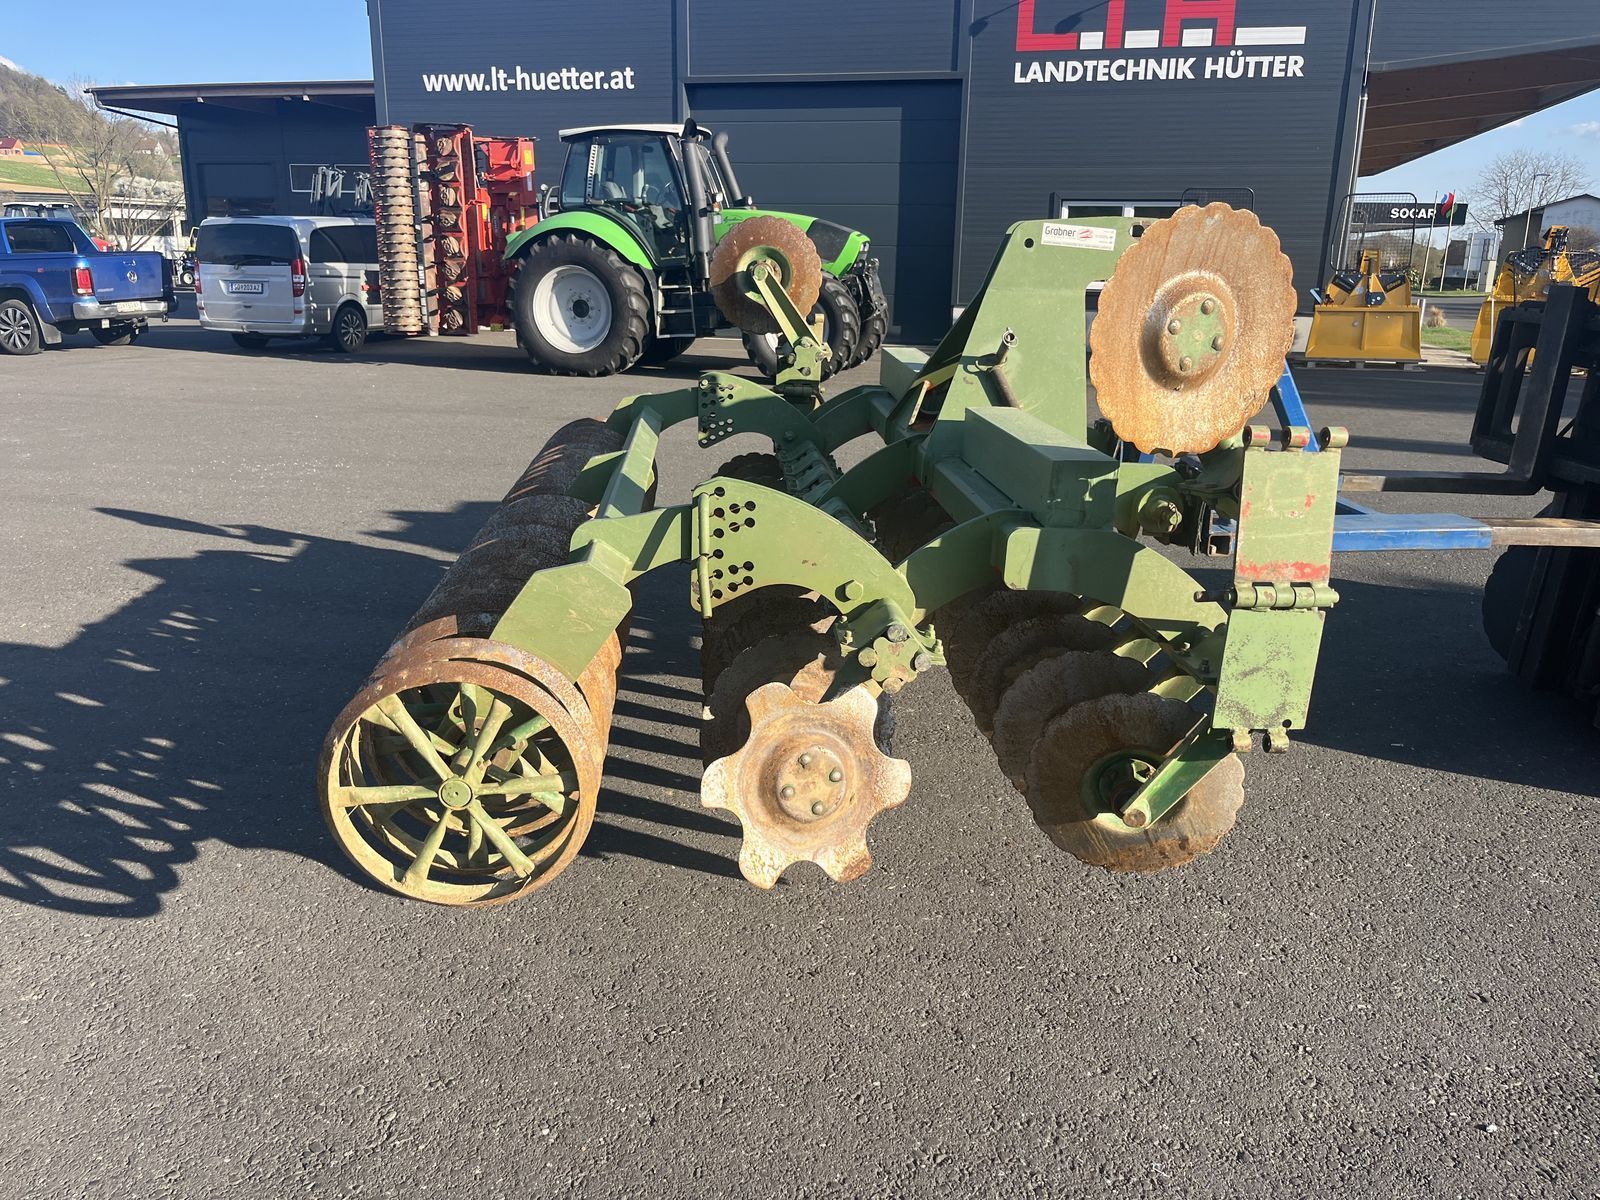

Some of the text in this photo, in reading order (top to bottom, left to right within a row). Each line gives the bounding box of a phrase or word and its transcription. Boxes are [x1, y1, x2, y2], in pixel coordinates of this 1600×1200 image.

[422, 66, 635, 92] www.lt-huetter.at
[1014, 50, 1304, 83] LANDTECHNIK HÜTTER
[1390, 208, 1436, 219] SOCAR
